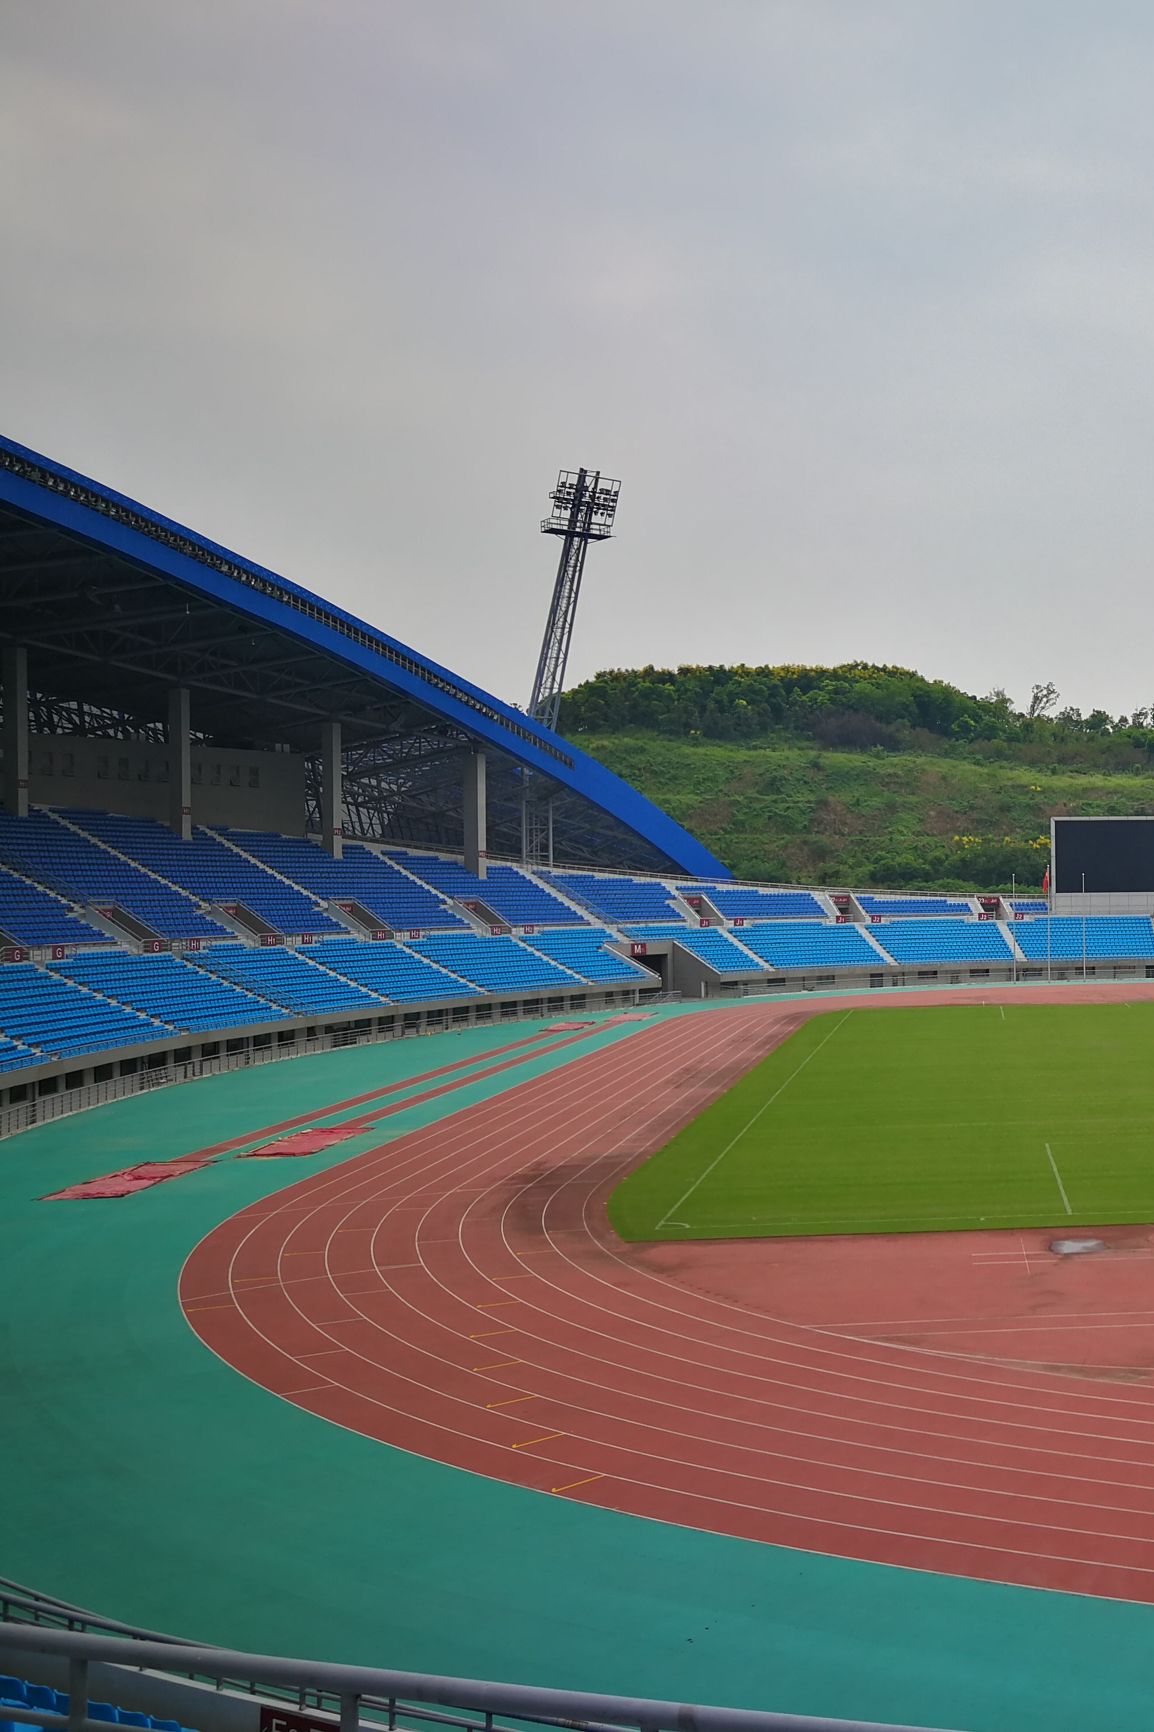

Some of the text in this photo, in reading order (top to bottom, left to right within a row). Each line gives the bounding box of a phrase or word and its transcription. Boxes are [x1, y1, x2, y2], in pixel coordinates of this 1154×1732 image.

[153, 942, 160, 952] G
[14, 950, 21, 961] G
[56, 948, 62, 958] G
